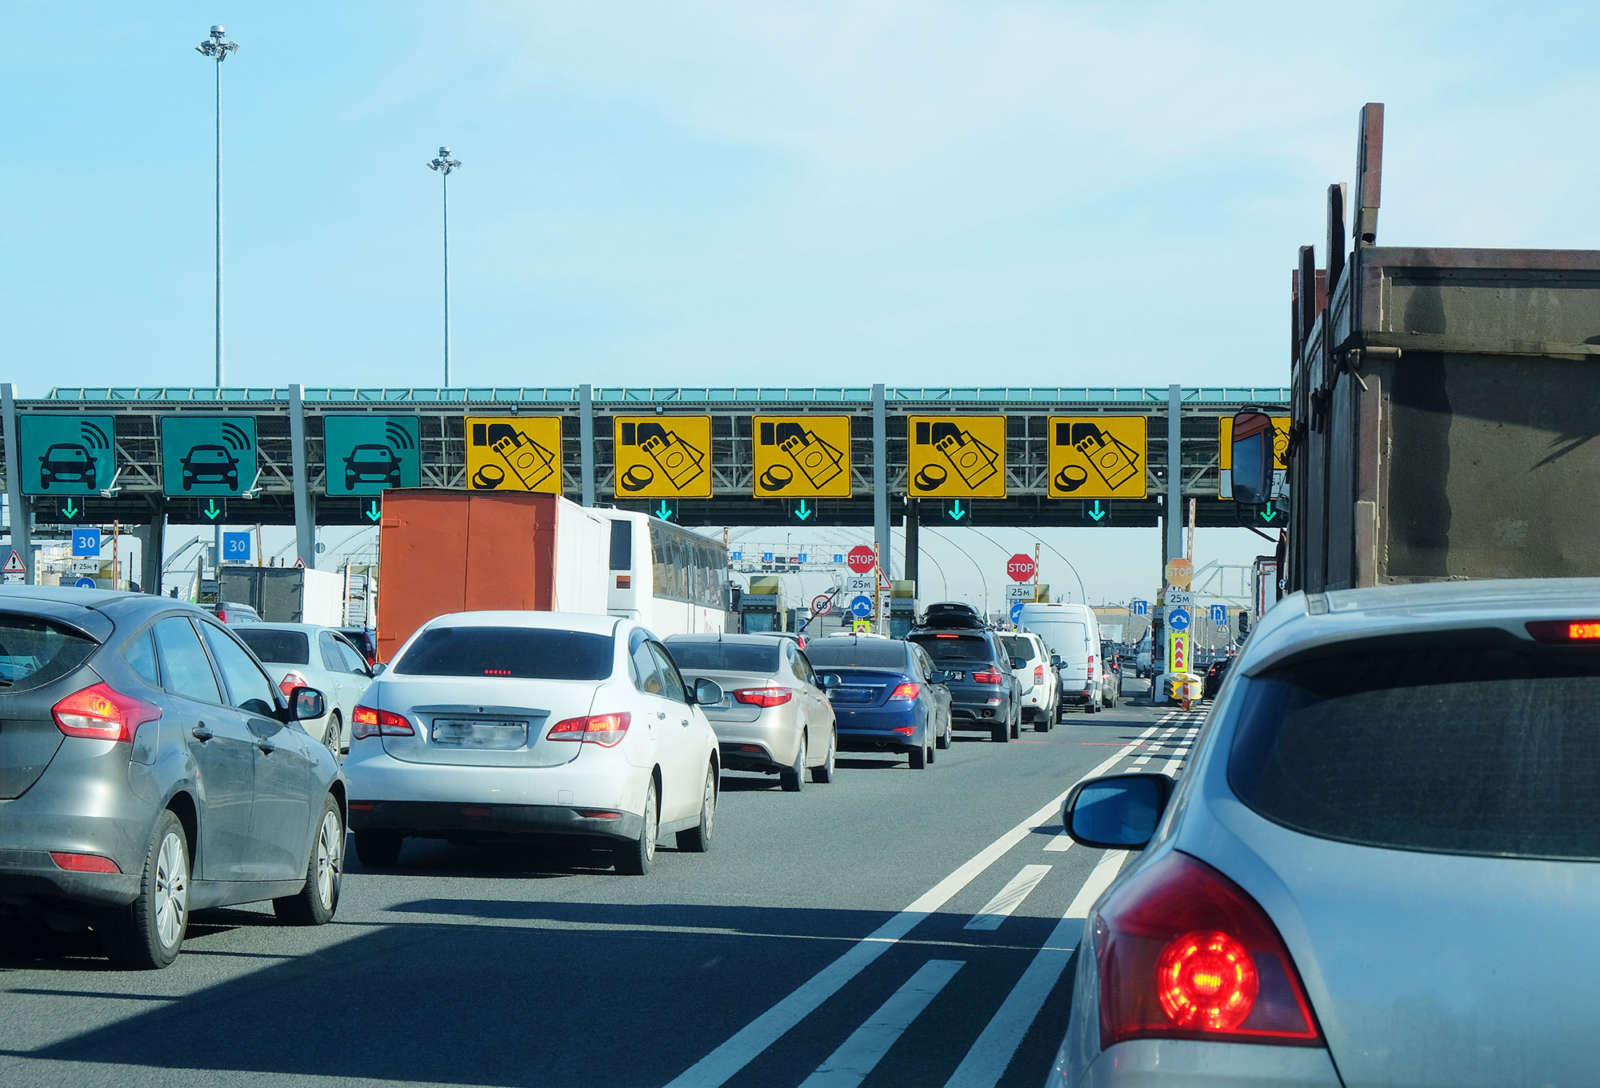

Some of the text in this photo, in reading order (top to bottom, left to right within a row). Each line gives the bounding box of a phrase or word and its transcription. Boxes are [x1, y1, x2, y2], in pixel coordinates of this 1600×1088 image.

[79, 536, 95, 549] 30
[230, 540, 246, 552] 30
[849, 554, 874, 565] STOP
[1008, 563, 1034, 573] STOP
[1167, 567, 1193, 577] STOP
